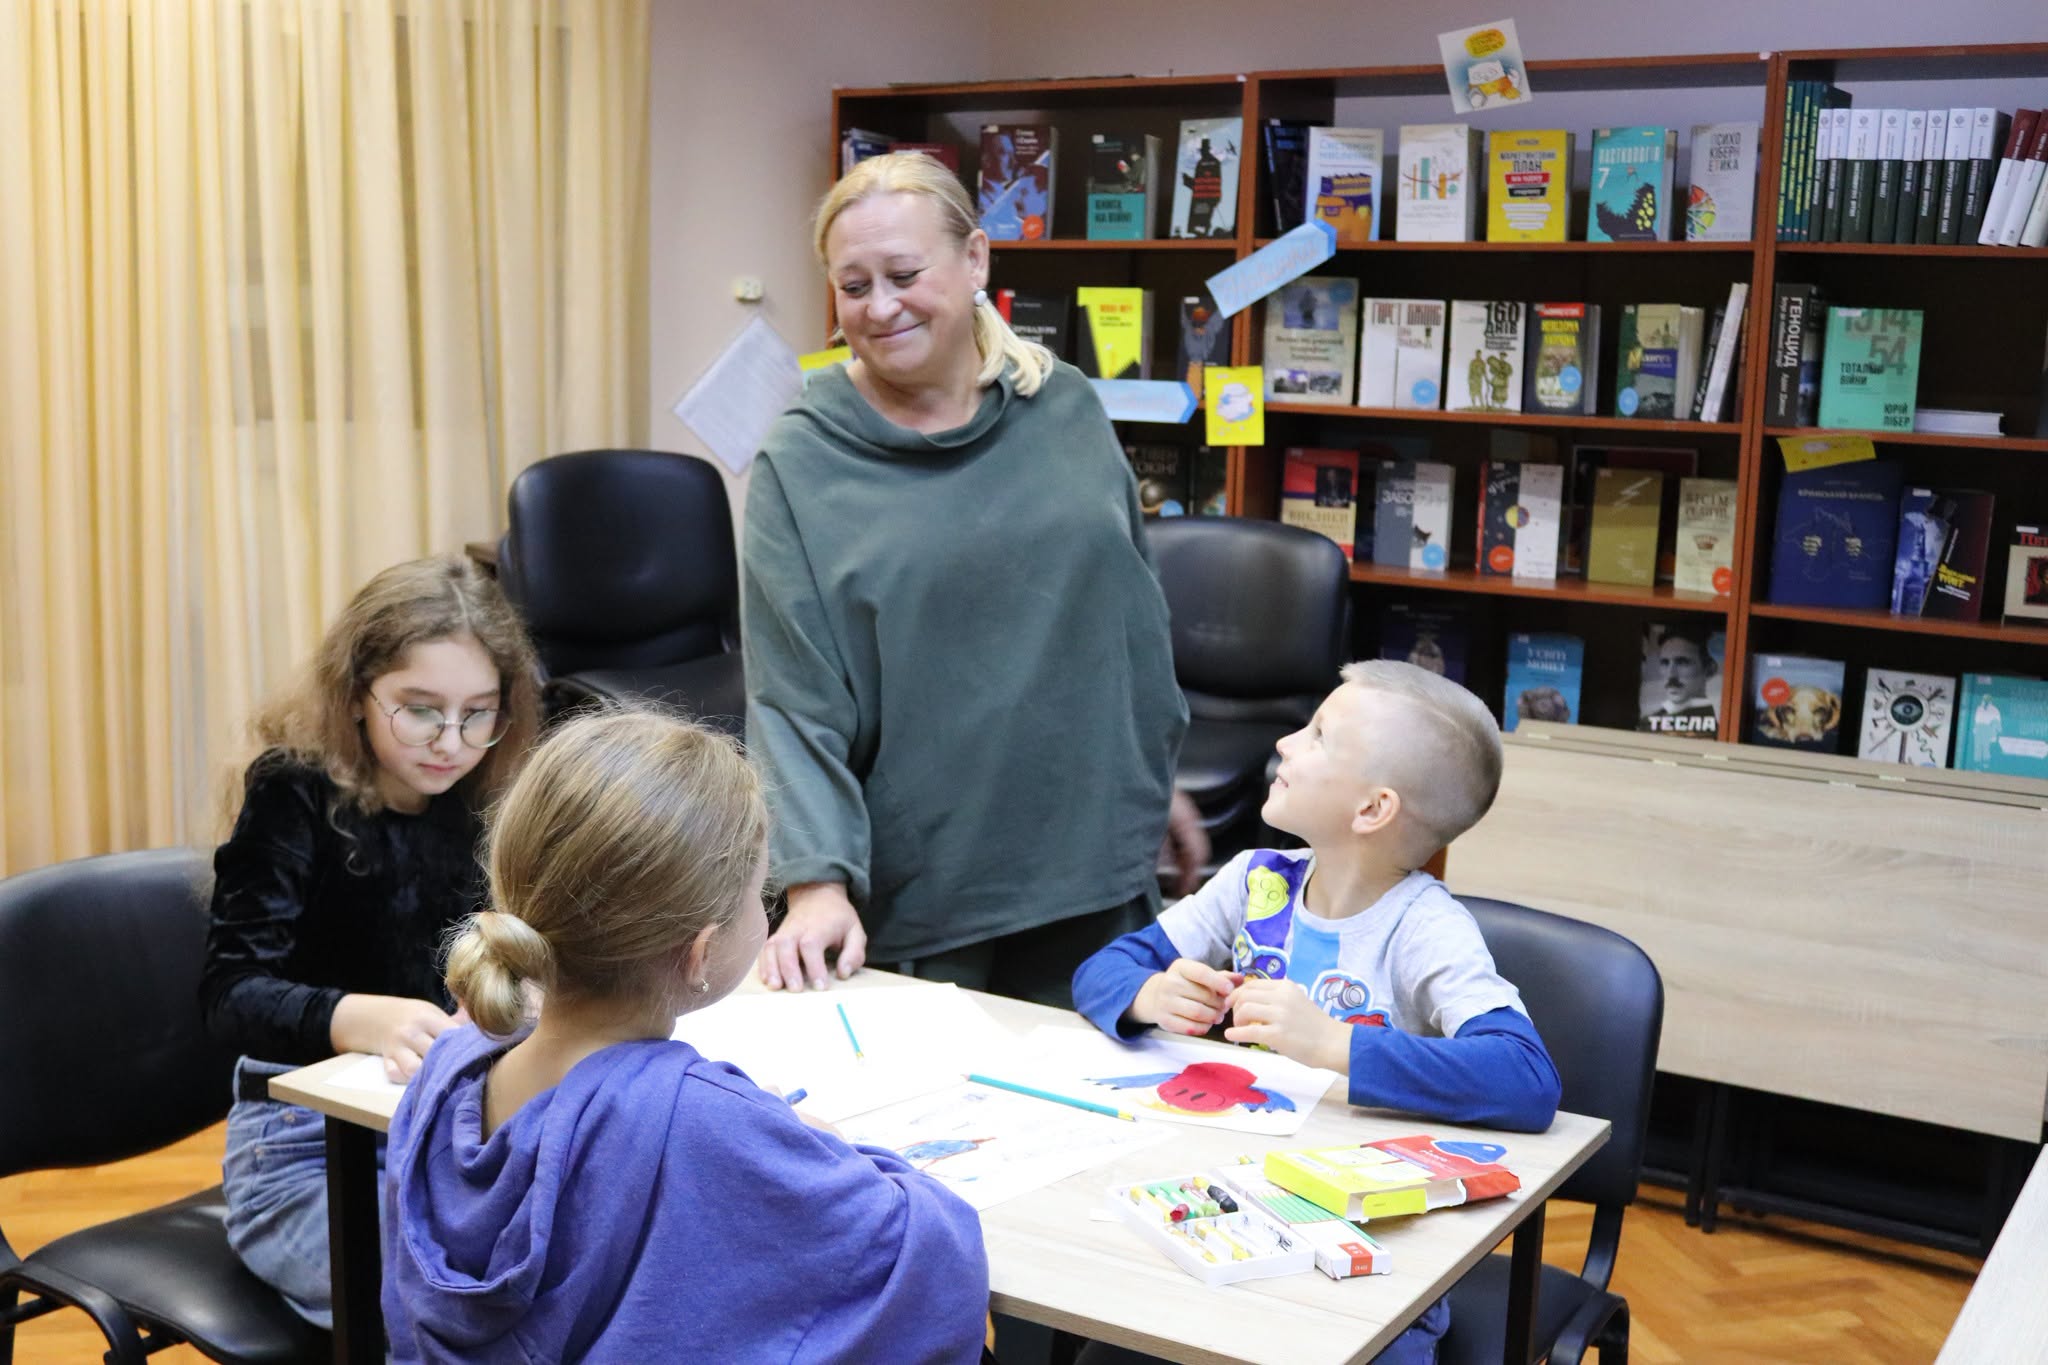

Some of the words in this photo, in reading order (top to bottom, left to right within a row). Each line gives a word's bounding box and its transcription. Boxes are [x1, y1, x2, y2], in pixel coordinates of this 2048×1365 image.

[1513, 160, 1542, 173] ПЛАН
[1707, 158, 1739, 173] ЕТИКА
[1485, 301, 1520, 322] 160
[1784, 296, 1802, 368] ГЕНОЦИД
[1649, 715, 1717, 732] ТЕСЛА
